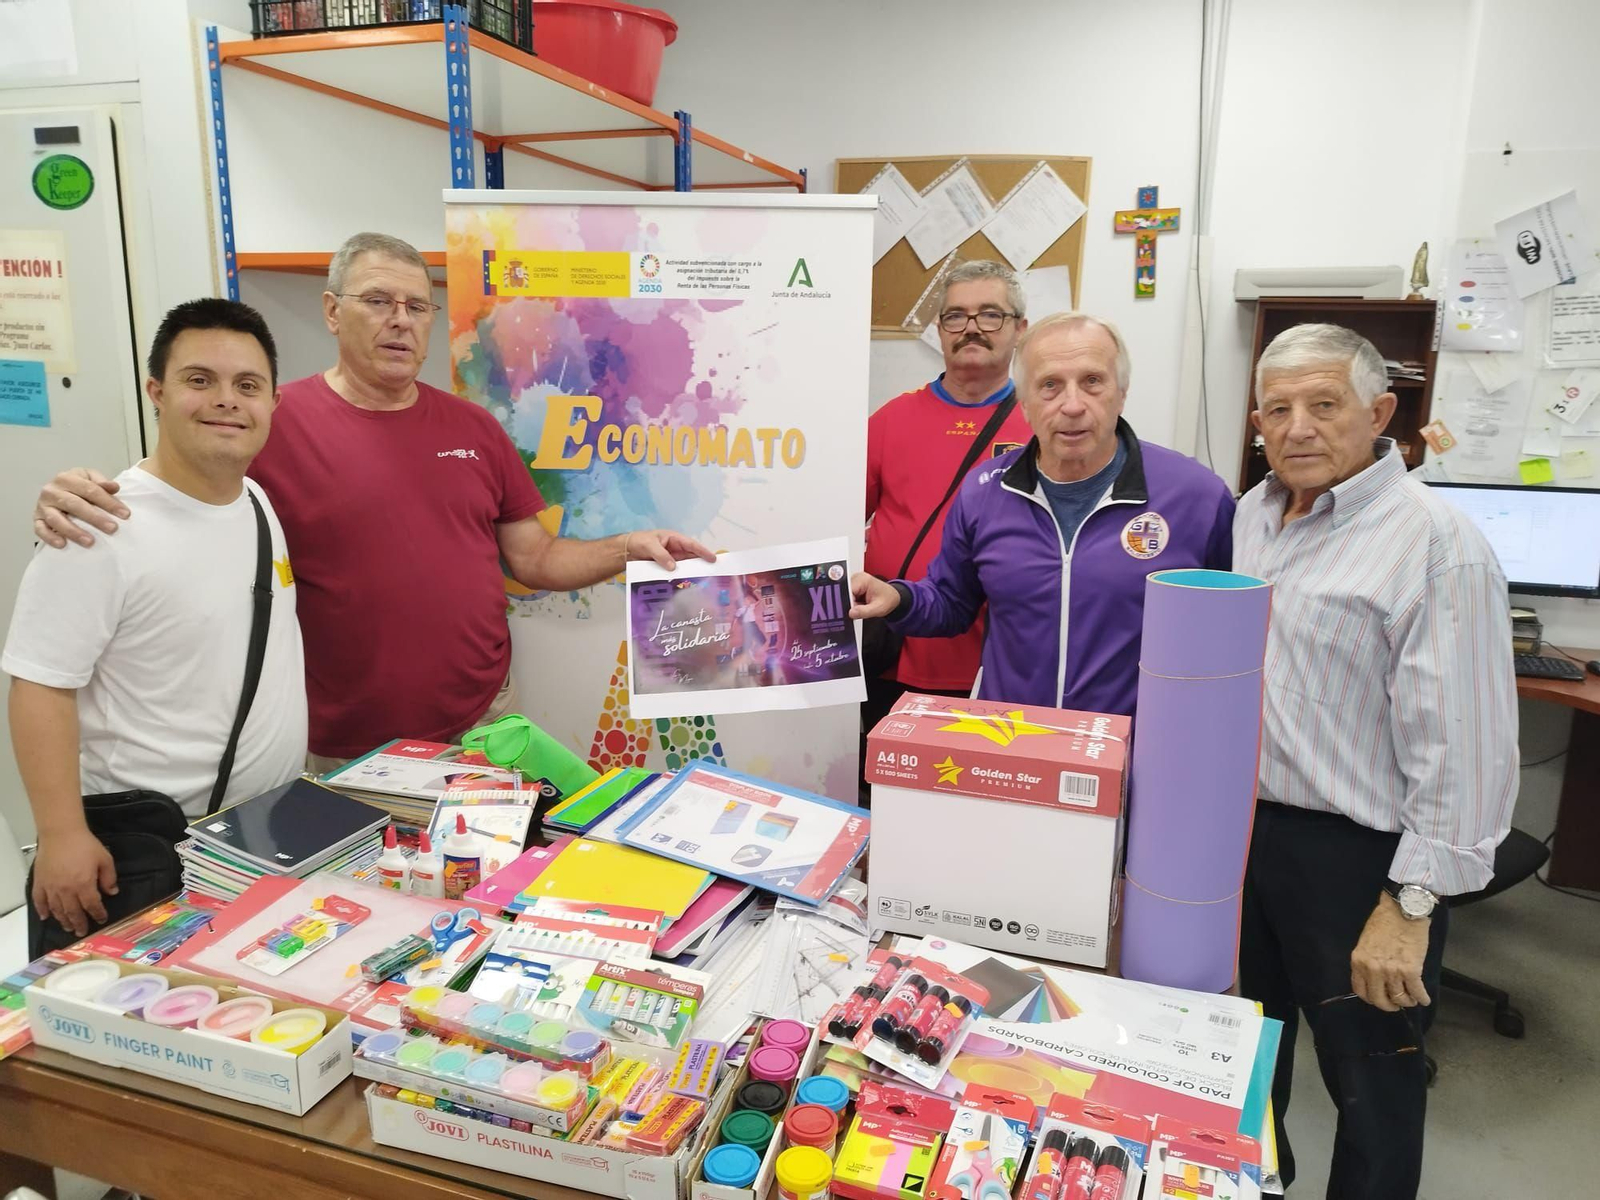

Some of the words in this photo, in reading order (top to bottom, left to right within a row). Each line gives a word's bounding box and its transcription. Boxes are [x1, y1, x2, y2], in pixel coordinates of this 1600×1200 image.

[638, 284, 662, 292] 2030
[530, 395, 807, 470] ECONOMATO
[808, 584, 844, 622] XII
[649, 610, 670, 642] La
[670, 608, 713, 628] canasta
[663, 627, 730, 656] solidaria
[790, 644, 802, 662] 25
[804, 640, 838, 658] septiembre
[815, 654, 822, 668] 5
[1089, 717, 1112, 742] Goldn
[877, 751, 896, 764] A4
[900, 754, 918, 767] 80
[896, 771, 918, 780] SHEETS
[972, 766, 1012, 780] Golden
[1016, 773, 1042, 784] Star
[980, 778, 1031, 790] PREMIUM
[53, 1019, 90, 1040] JOVI
[104, 1032, 160, 1058] FINGER
[165, 1048, 213, 1072] PAINT
[988, 1026, 1084, 1058] CARDBOARDS
[688, 1044, 702, 1070] PLASTILINA
[1211, 1052, 1232, 1063] A3
[1088, 1054, 1169, 1082] COLOURED
[1172, 1080, 1195, 1090] OF
[1200, 1086, 1231, 1100] PAD
[662, 1098, 684, 1120] PLASTILINA
[1050, 1110, 1066, 1118] MP
[548, 1113, 562, 1128] CE
[862, 1120, 878, 1129] MP
[427, 1122, 464, 1138] JOVI
[477, 1132, 554, 1160] PLASTILINA
[890, 1128, 912, 1136] Adhesive
